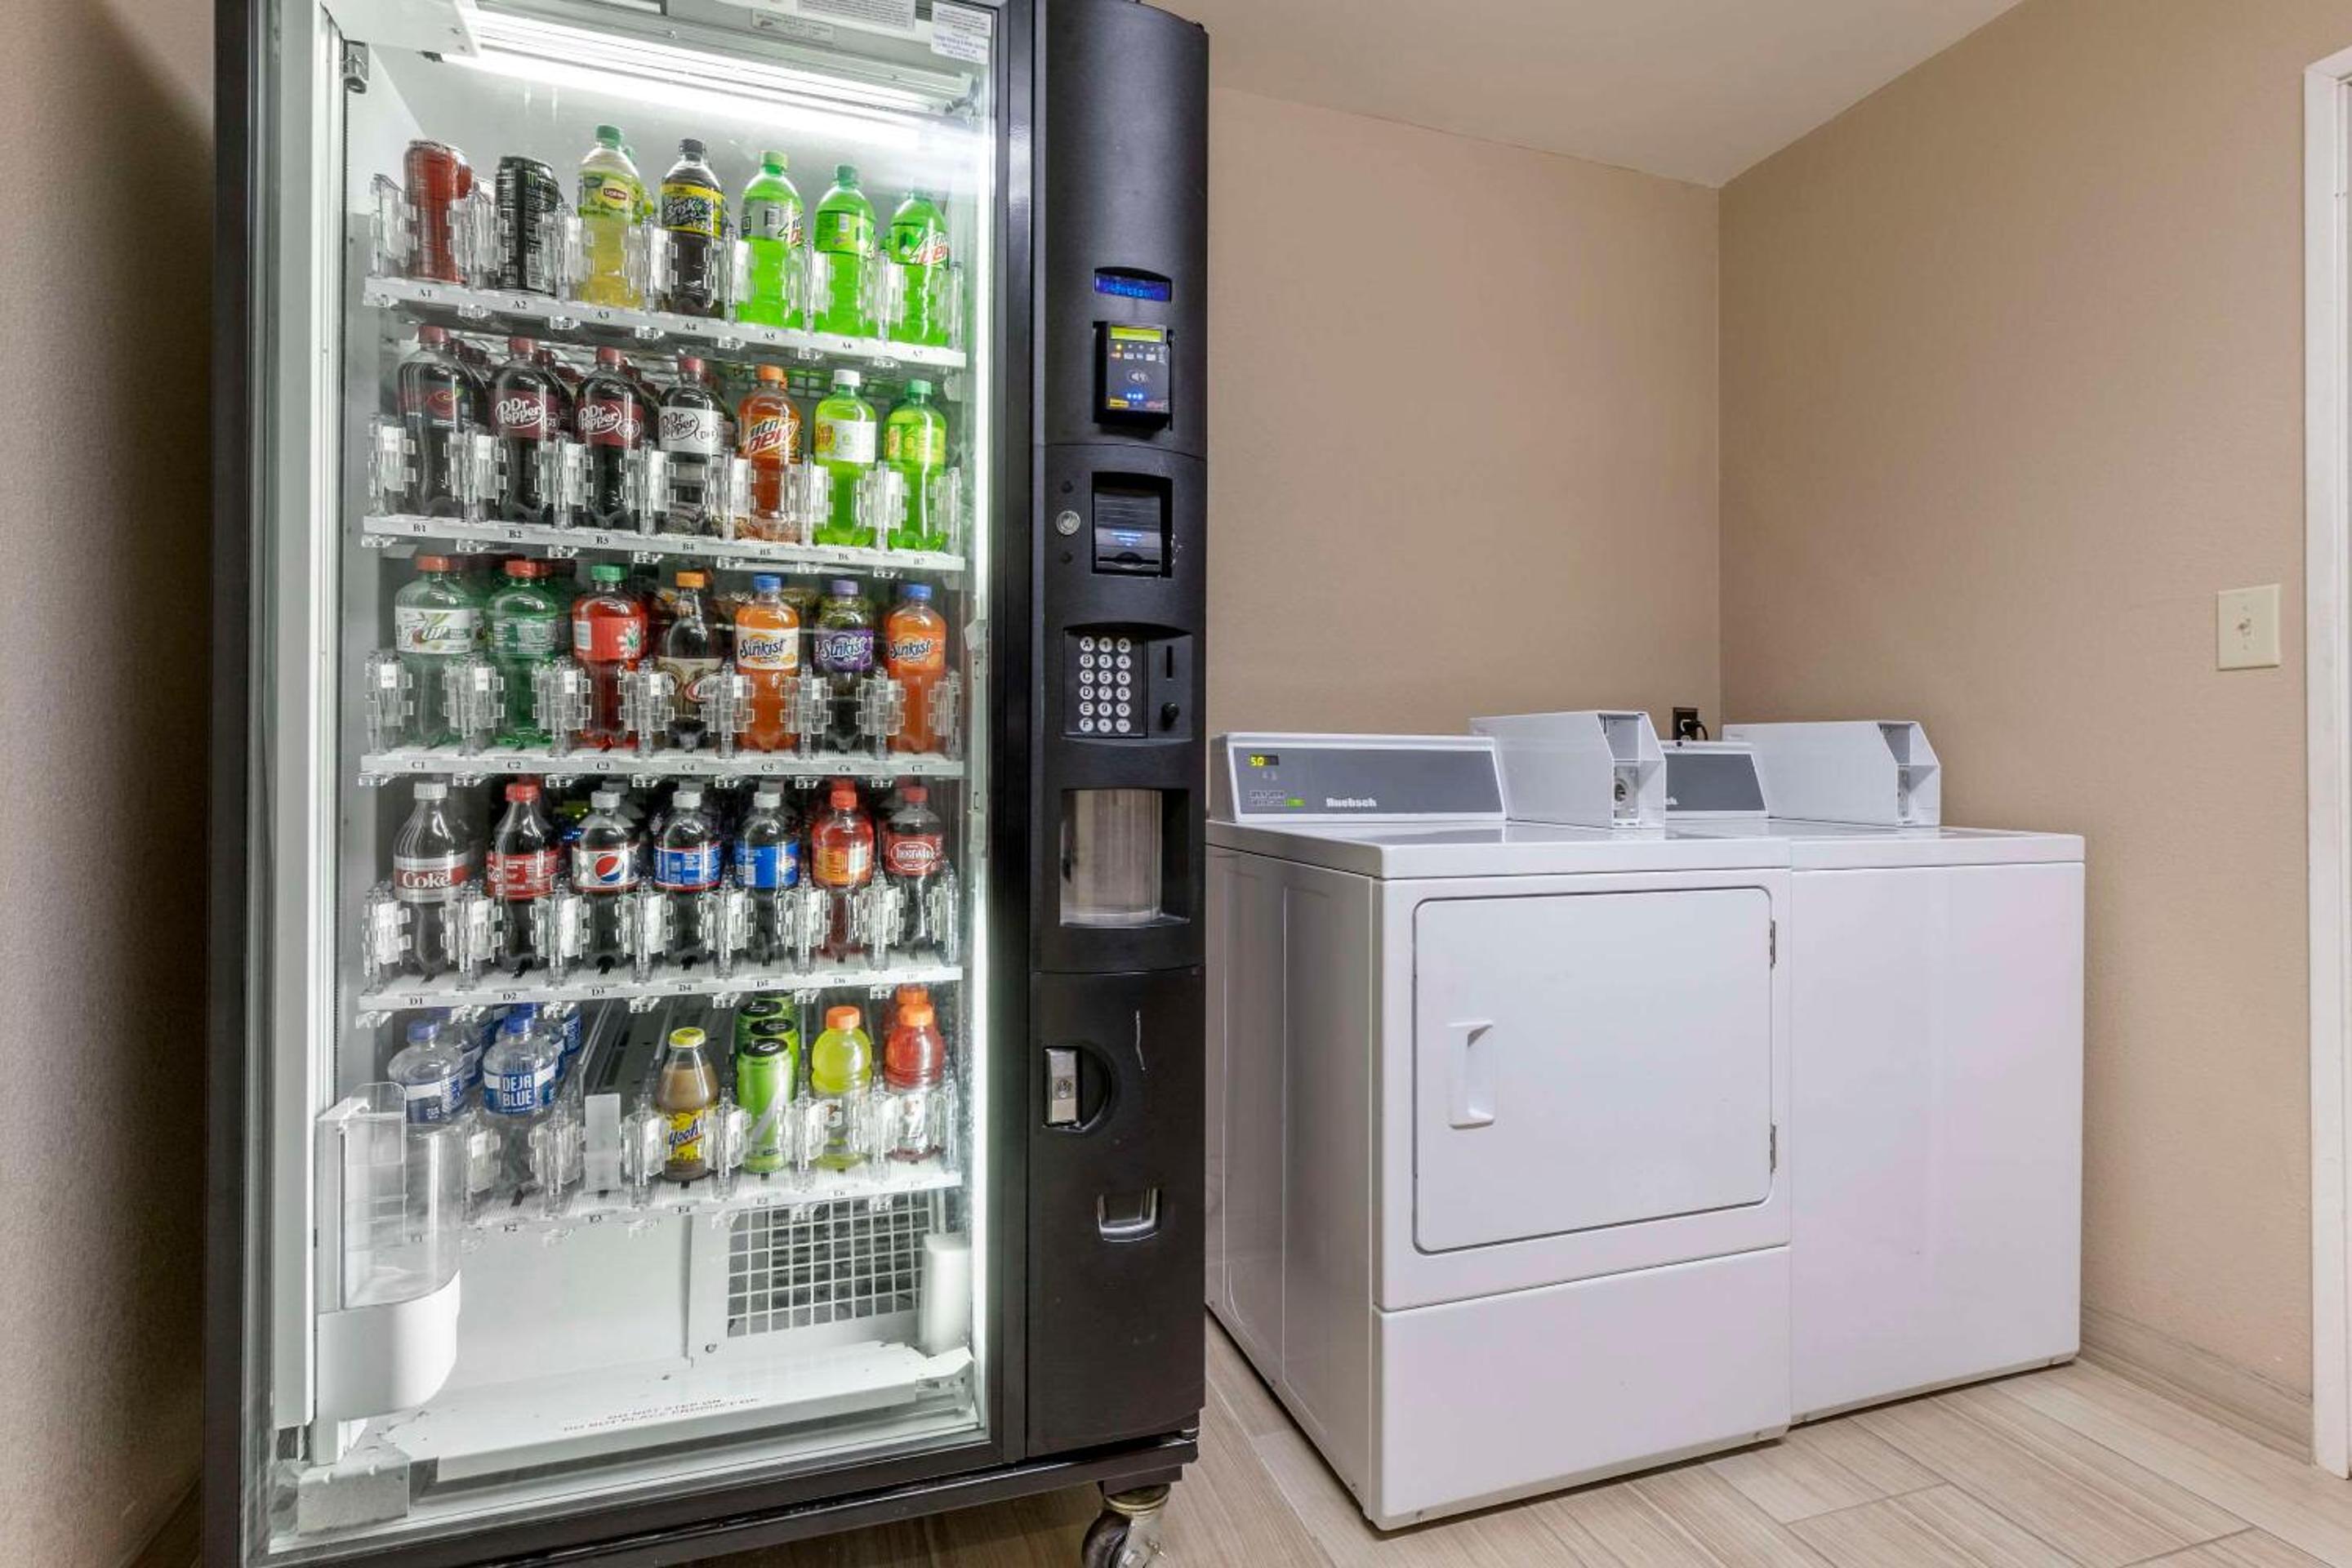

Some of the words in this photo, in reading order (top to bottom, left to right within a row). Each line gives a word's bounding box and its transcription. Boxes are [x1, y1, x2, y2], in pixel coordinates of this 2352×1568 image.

[513, 301, 526, 310] A2
[596, 311, 609, 319] A3
[684, 323, 697, 331] A4
[510, 398, 529, 412] Dr
[590, 405, 606, 416] Dr
[498, 400, 541, 424] Pepper
[669, 412, 684, 423] Dr
[579, 408, 618, 430] Pepper
[659, 416, 696, 438] Pepper
[413, 523, 425, 532] B1
[683, 543, 694, 551] B4
[740, 638, 786, 658] Sunkist
[820, 637, 866, 660] Sunkist
[890, 638, 932, 659] Sunkist
[412, 761, 425, 769] C1
[508, 761, 520, 769] C2
[597, 762, 609, 770] C3
[762, 764, 773, 772] C5
[402, 870, 451, 889] Coke
[502, 1075, 532, 1091] DEJA
[502, 1089, 532, 1107] BLUE
